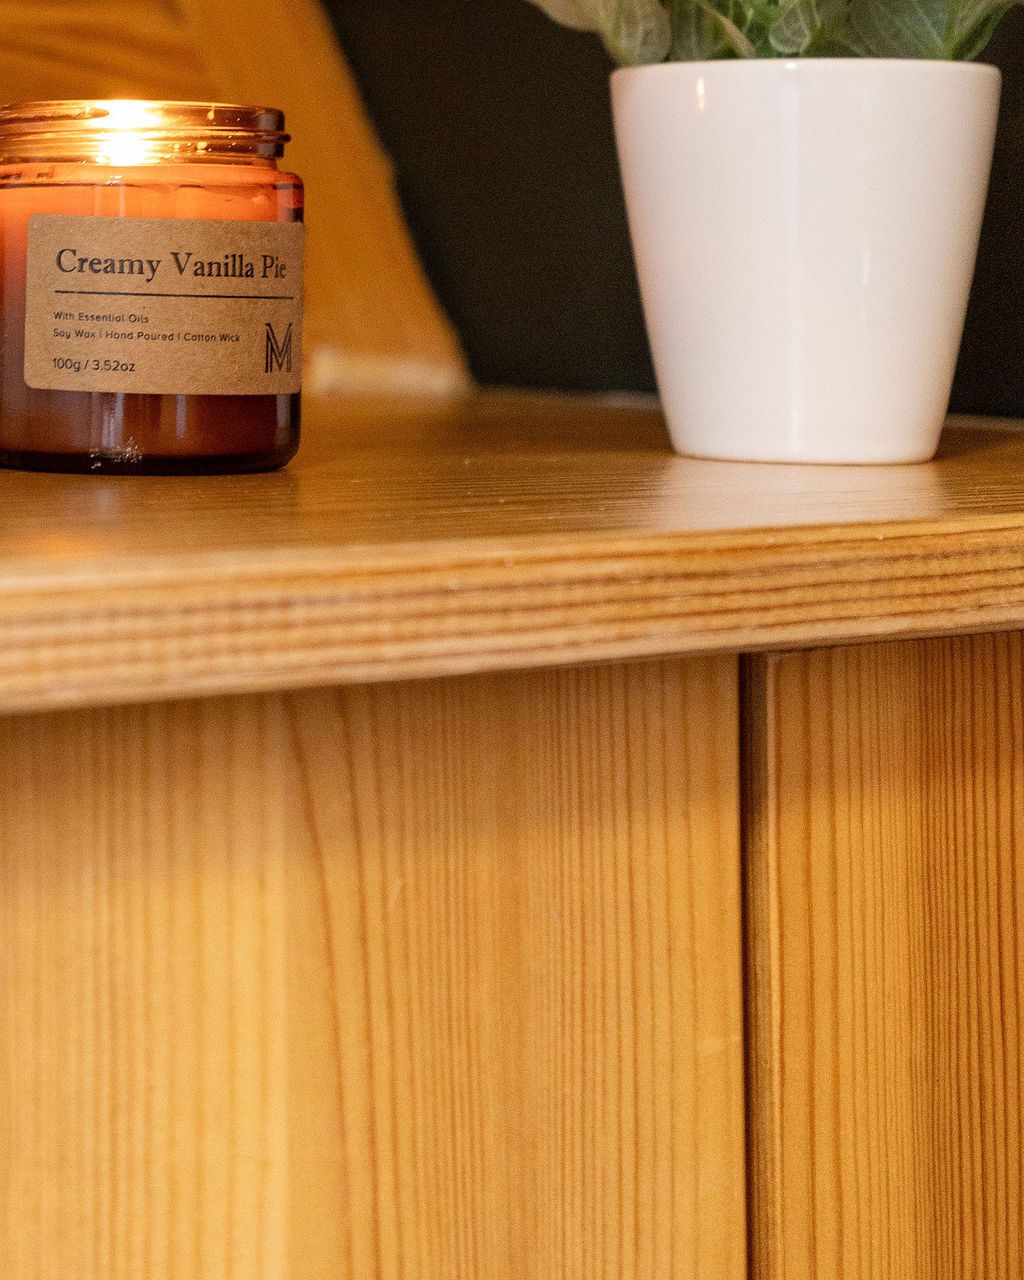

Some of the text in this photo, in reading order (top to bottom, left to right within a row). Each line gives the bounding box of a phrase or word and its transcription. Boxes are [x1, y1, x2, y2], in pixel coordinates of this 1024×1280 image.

[55, 248, 287, 282] Creamy Vanilla Pie
[53, 311, 149, 324] With Essential Oils
[53, 328, 71, 340] Soy
[74, 329, 96, 339] Wax
[106, 330, 134, 340] Hand
[137, 331, 174, 342] Poured
[184, 332, 216, 342] Cotton
[219, 333, 241, 343] Wick
[264, 322, 293, 373] M
[52, 358, 81, 372] 100g
[92, 359, 136, 372] 3.52oz
